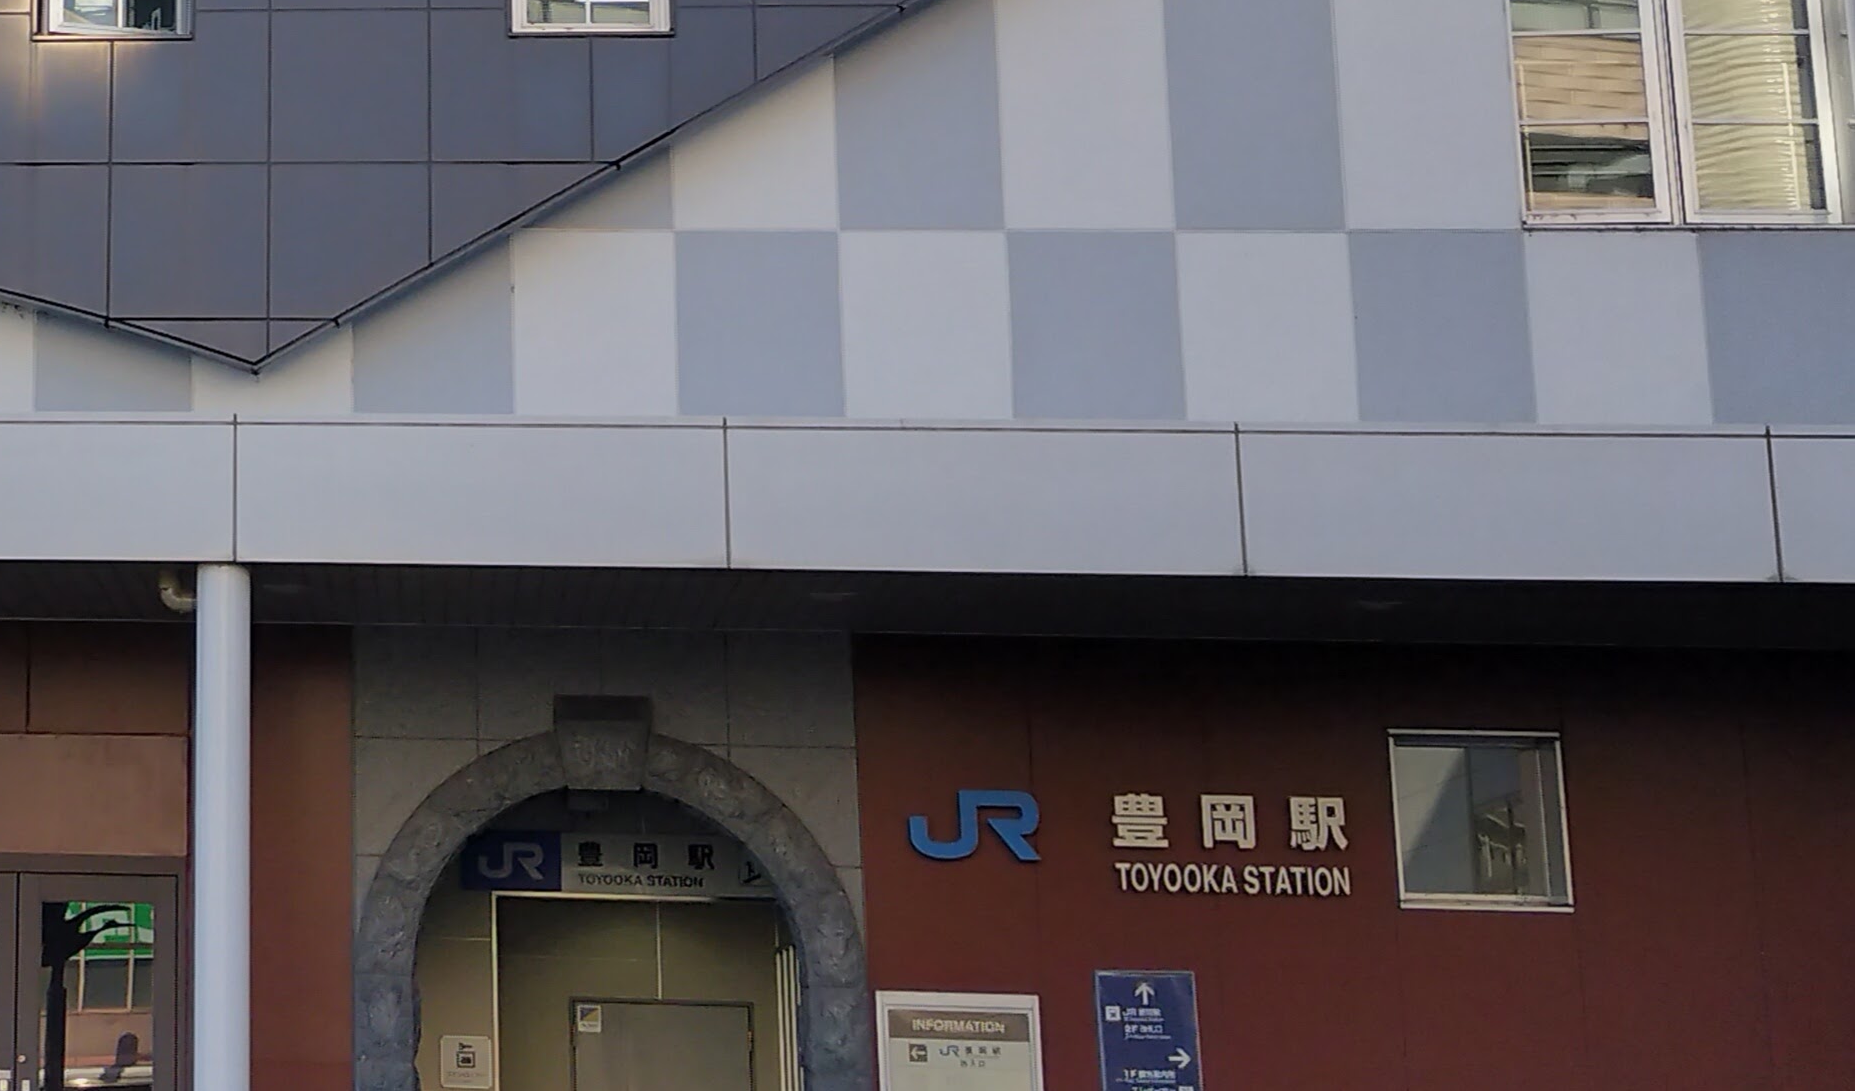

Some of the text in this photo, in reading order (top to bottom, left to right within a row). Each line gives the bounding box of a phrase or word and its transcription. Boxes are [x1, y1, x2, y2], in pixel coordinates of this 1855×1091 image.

[909, 789, 1041, 861] JR
[1111, 793, 1348, 851] 豊岡駅
[478, 842, 544, 880] JR
[577, 840, 715, 870] 豊岡駅
[578, 873, 705, 888] TOYOOKA STATION
[1114, 862, 1352, 897] TOYOOKA STATION
[911, 1018, 1006, 1034] INFORMATION
[939, 1044, 960, 1057] JR
